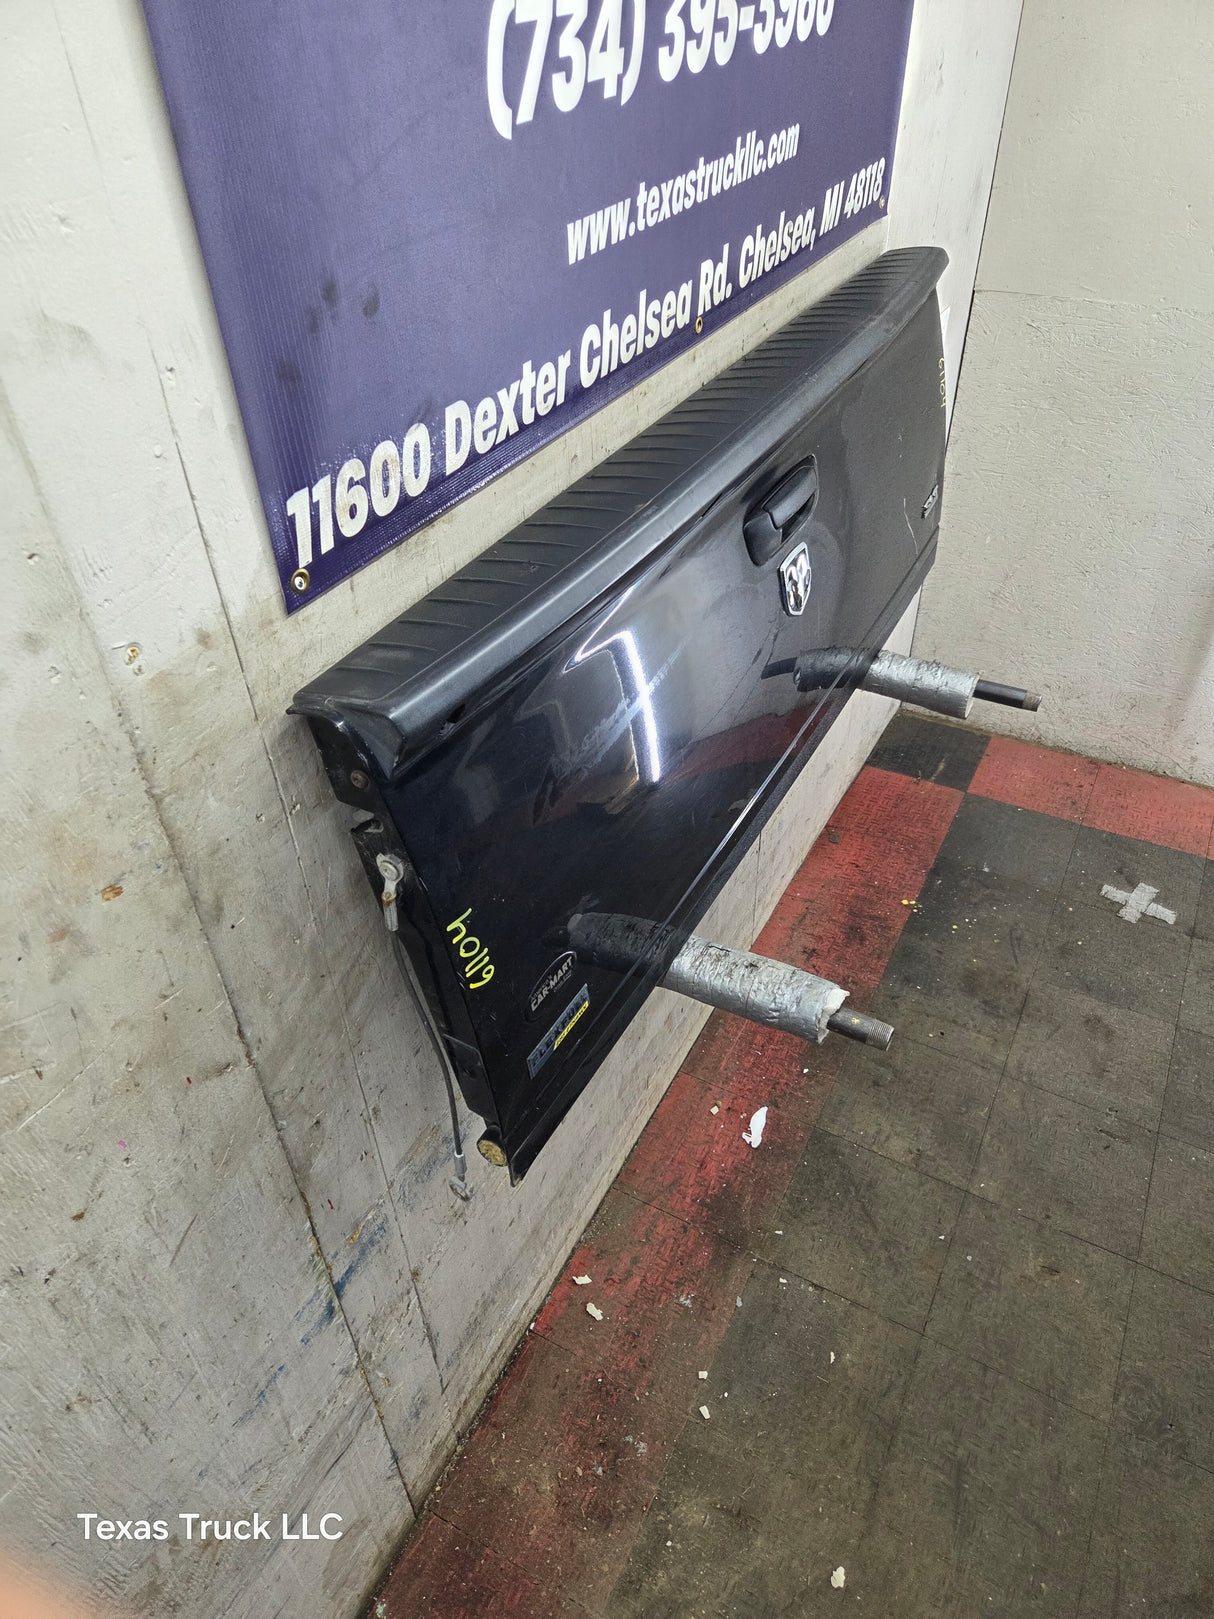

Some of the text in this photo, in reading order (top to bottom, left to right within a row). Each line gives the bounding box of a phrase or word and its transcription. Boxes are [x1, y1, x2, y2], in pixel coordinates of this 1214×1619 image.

[487, 0, 646, 140] (734)
[567, 123, 800, 265] www.texastruckllc.com
[286, 157, 886, 569] 11600 Dexter Chelsea Rd. Chelsea, MI 48118
[530, 956, 574, 1013] CAR-MART
